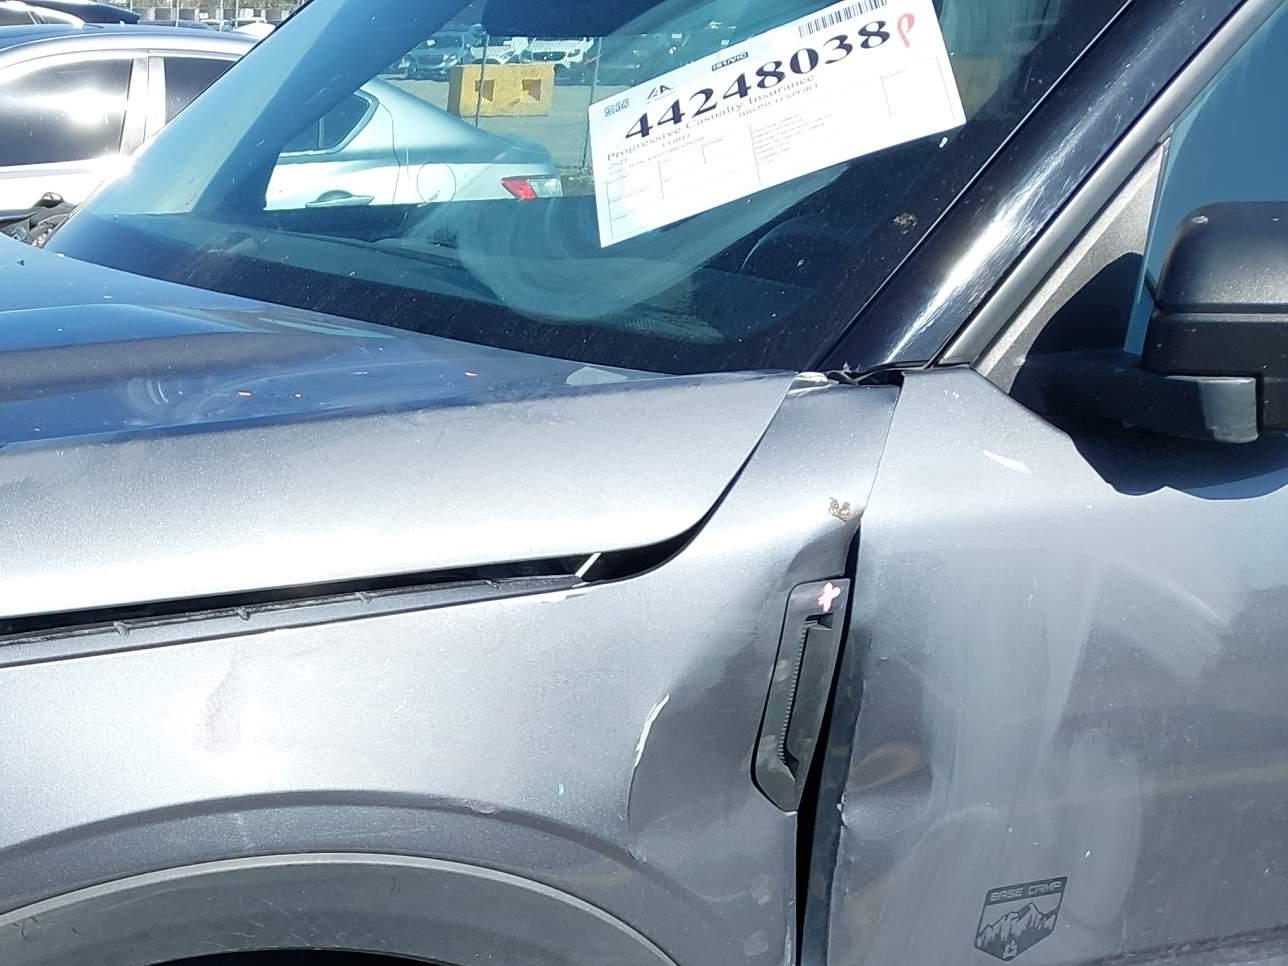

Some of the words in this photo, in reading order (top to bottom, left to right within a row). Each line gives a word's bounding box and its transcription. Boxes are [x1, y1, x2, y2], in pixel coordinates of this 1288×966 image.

[607, 127, 682, 161] Progressive
[685, 102, 743, 129] Casualty
[749, 75, 815, 105] Insurance
[625, 19, 891, 141] 44248038
[989, 888, 1023, 902] BASE
[1027, 882, 1062, 895] CAMP
